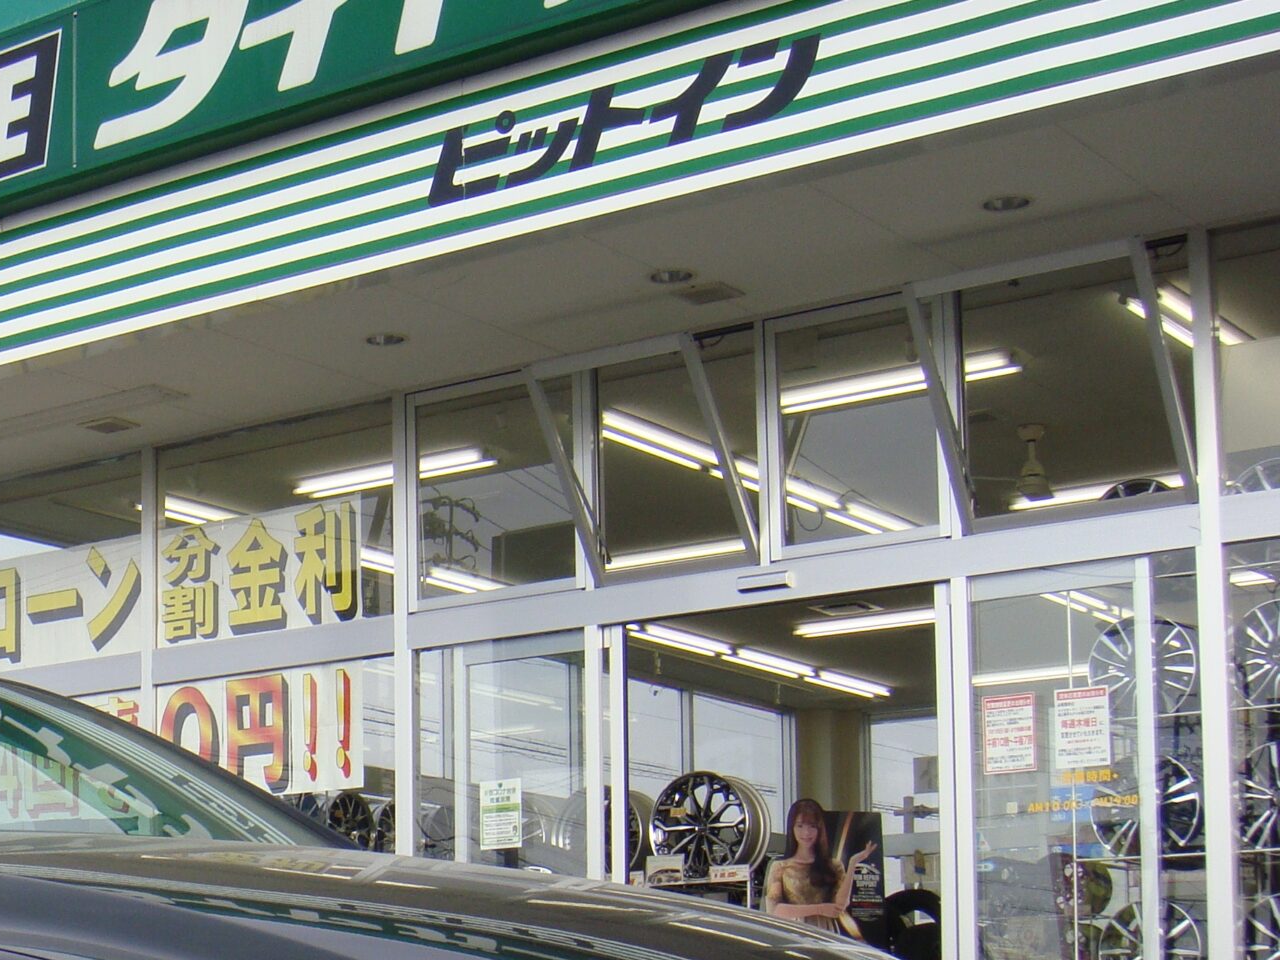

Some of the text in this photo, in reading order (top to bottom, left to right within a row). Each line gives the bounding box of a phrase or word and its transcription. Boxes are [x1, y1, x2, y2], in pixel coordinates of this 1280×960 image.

[428, 33, 821, 207] ピットイン
